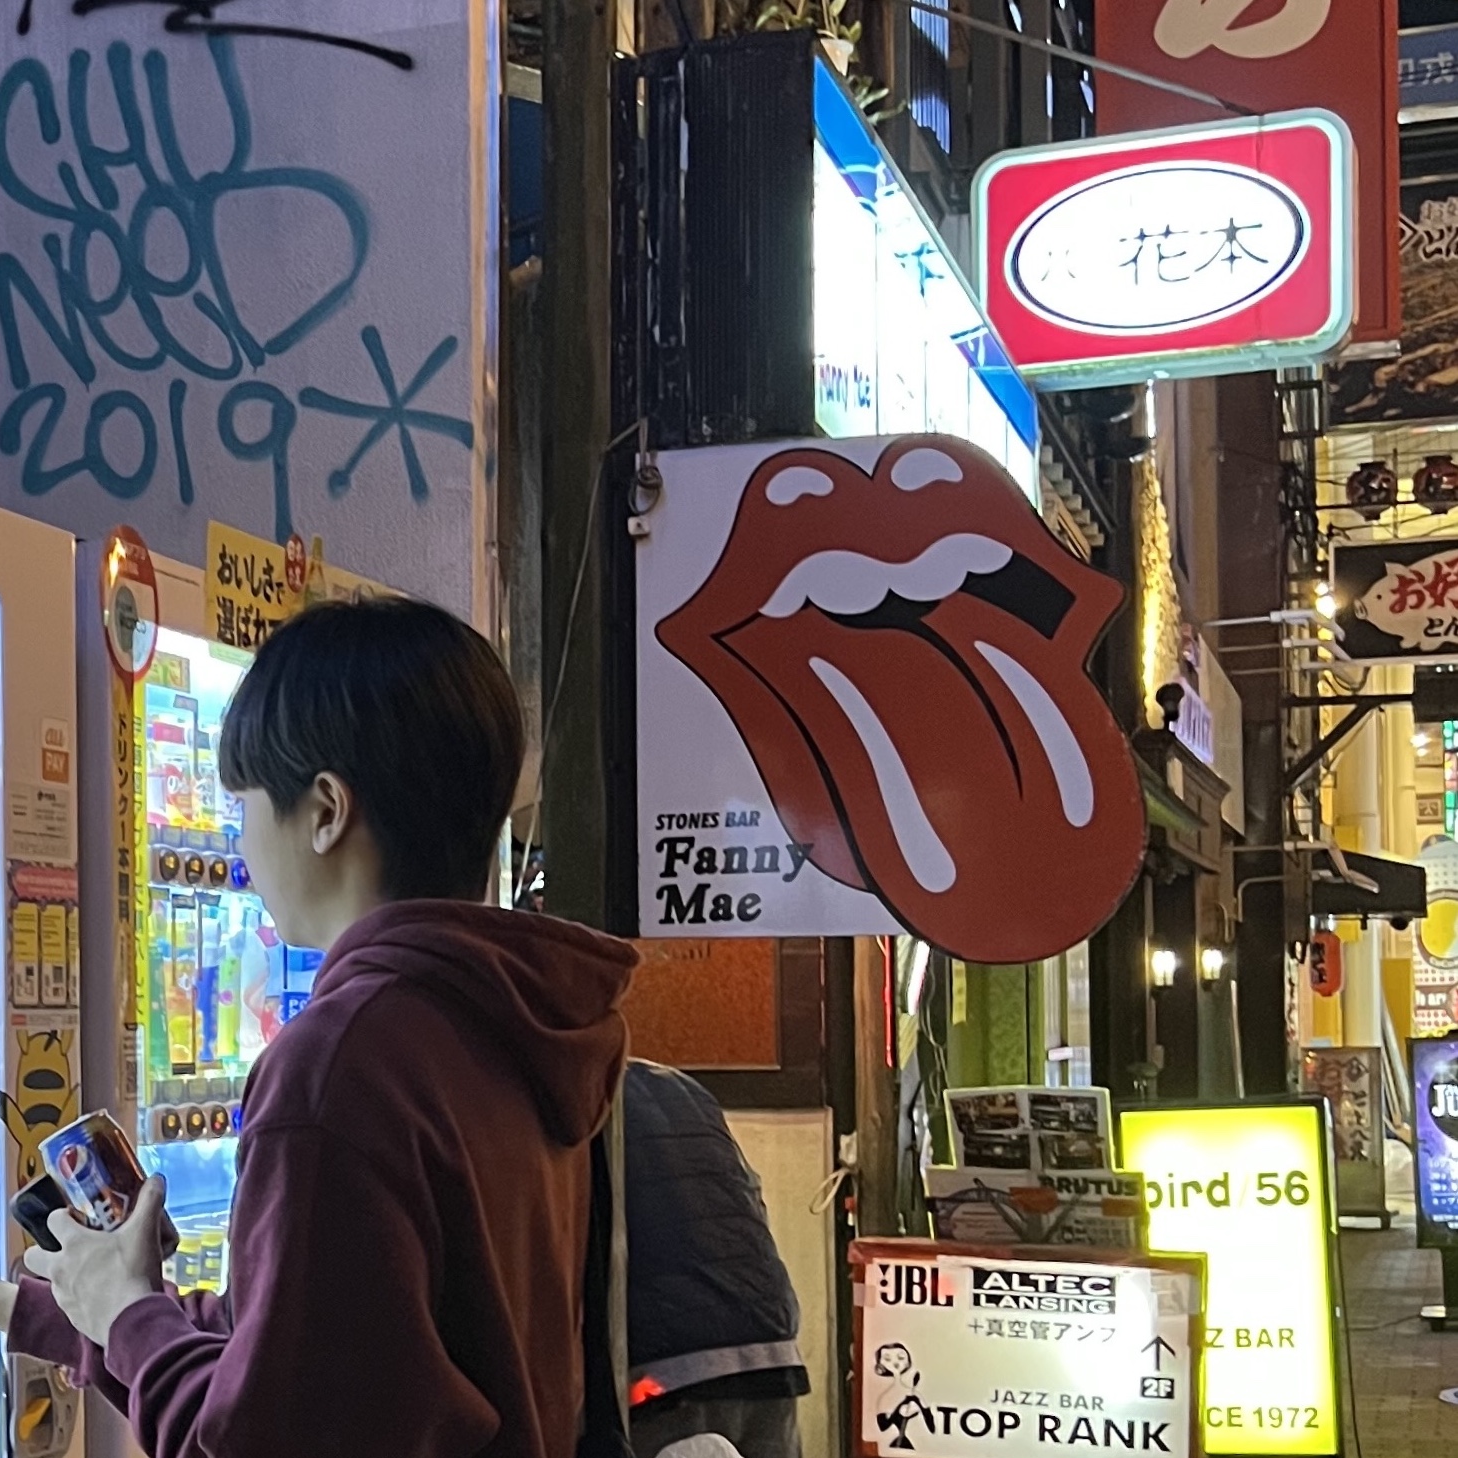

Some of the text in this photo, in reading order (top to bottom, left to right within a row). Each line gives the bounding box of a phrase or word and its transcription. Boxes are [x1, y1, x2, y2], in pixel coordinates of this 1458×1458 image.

[1119, 218, 1268, 284] 花本
[216, 543, 285, 605] おいしさで
[46, 751, 66, 770] PAY
[655, 811, 761, 831] STONES BAR
[655, 836, 814, 883] Fanny
[656, 883, 762, 925] Mae
[1256, 1171, 1309, 1206] 56
[880, 1264, 954, 1307] JBL
[982, 1270, 1111, 1296] ALTEC
[979, 1294, 1112, 1314] LANSING
[1205, 1328, 1294, 1348] Z BAR
[991, 1388, 1104, 1410] JAZZ BAR
[1144, 1378, 1173, 1397] 2F
[937, 1407, 1173, 1452] TOP RANK
[1206, 1407, 1319, 1429] CE 1972
